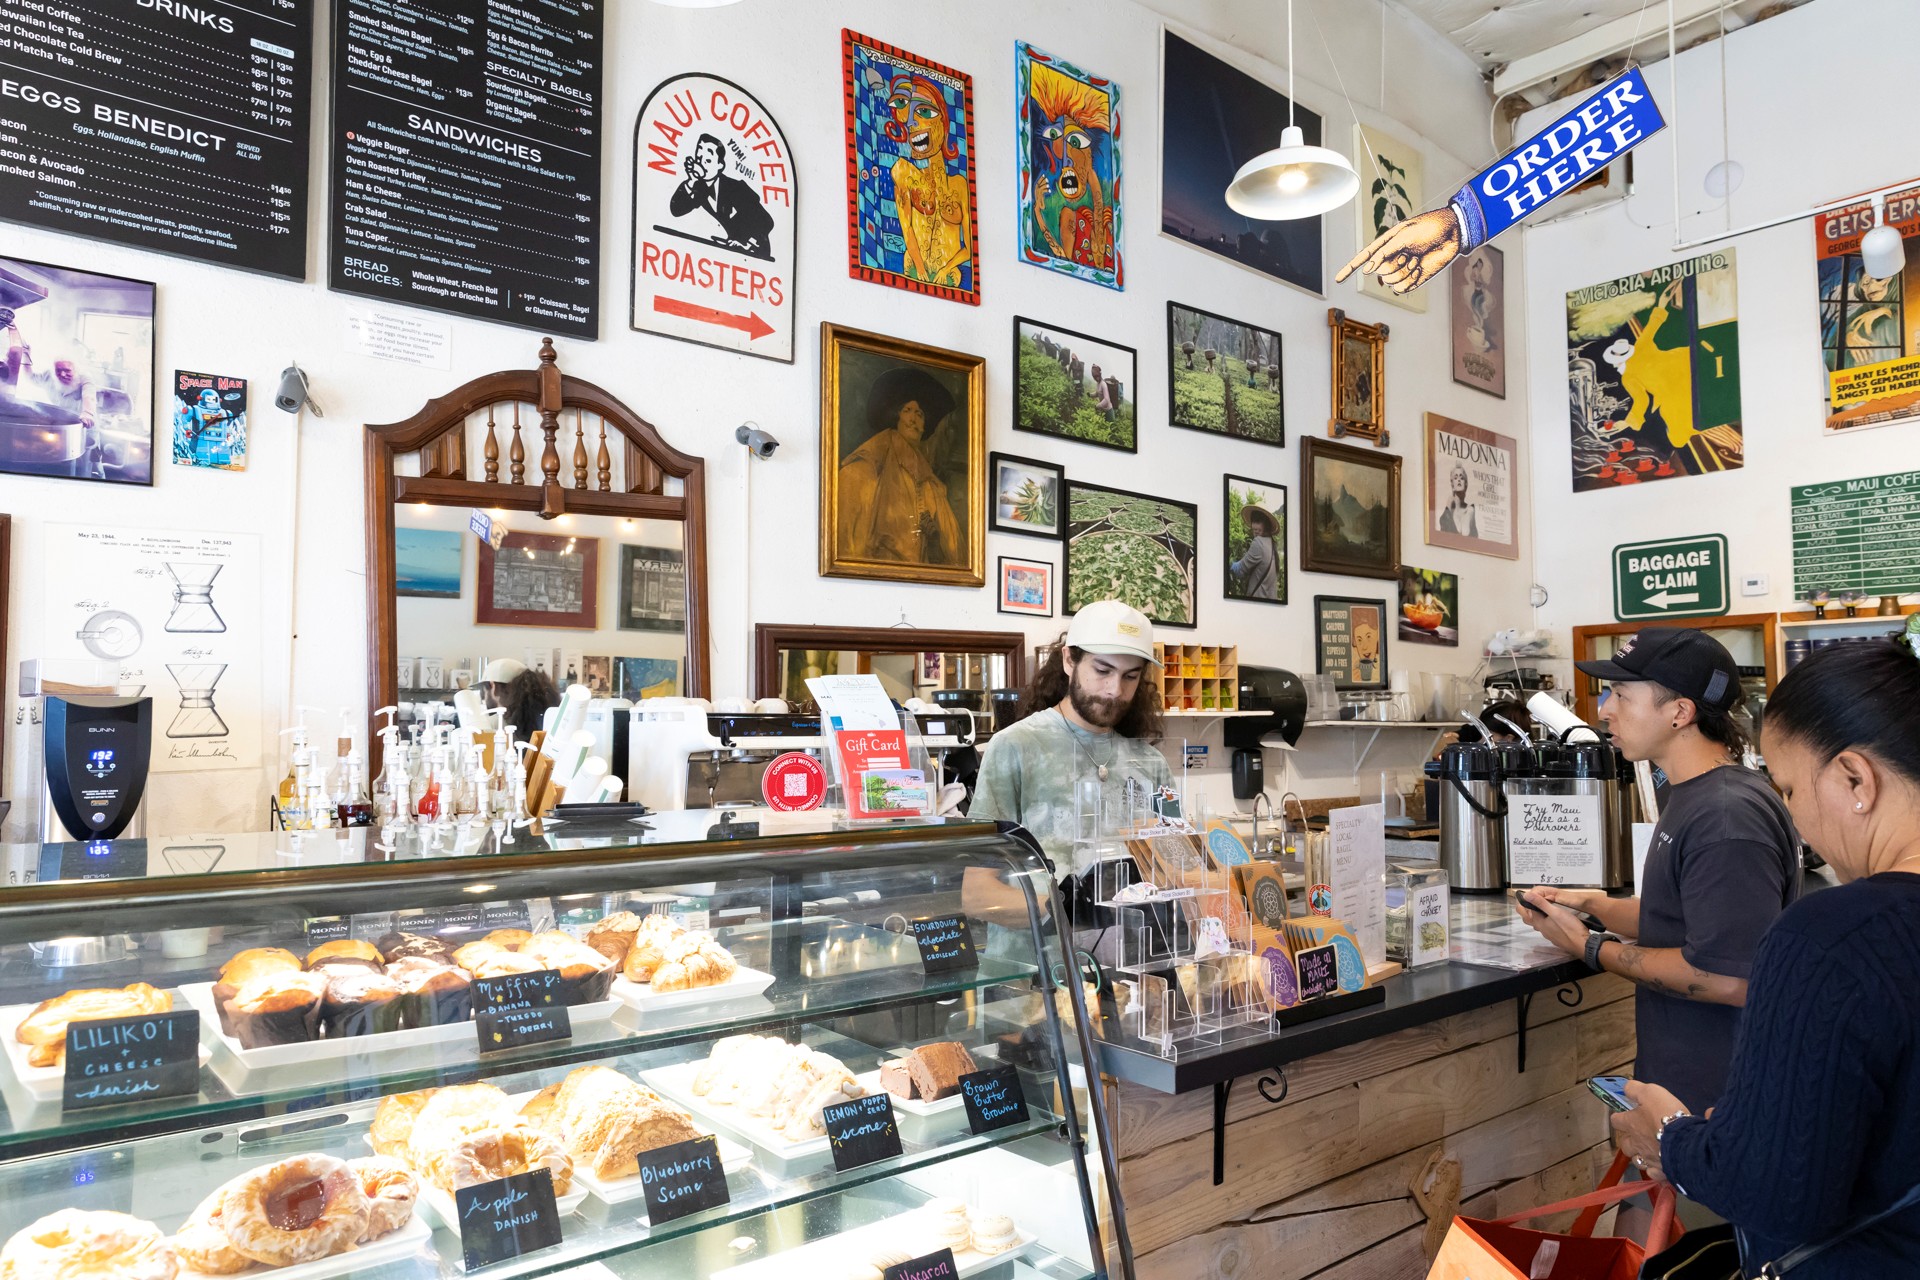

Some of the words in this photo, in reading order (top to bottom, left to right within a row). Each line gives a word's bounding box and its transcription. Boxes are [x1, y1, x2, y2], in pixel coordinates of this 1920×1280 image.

[47, 6, 81, 24] Coffee
[48, 21, 64, 33] Ice
[66, 26, 84, 39] Tea
[348, 10, 379, 27] Smoked
[381, 21, 410, 37] Salmon
[411, 30, 432, 44] Bagel
[14, 25, 67, 49] Chocolate
[70, 42, 92, 56] Cold
[95, 49, 122, 64] Brew
[14, 40, 53, 60] Matcha
[56, 53, 74, 66] Tea
[509, 36, 529, 49] Bacon
[530, 42, 554, 58] Burrito
[348, 55, 381, 72] Cheddar
[382, 65, 410, 81] Cheese
[411, 74, 432, 87] Bagel
[486, 61, 546, 87] SPECIALTY
[550, 81, 593, 102] BAGELS
[486, 79, 523, 97] Sourdough
[524, 90, 547, 104] Bagels
[2, 79, 81, 114] EGGS
[94, 104, 226, 151] BENEDICT
[486, 99, 513, 114] Organic
[514, 107, 537, 120] Bagels
[73, 123, 95, 136] Eggs,
[97, 129, 148, 149] Hollandaise,
[150, 143, 178, 157] English
[180, 150, 206, 163] Muffin
[356, 133, 383, 149] Veggie
[384, 141, 410, 155] Burger
[408, 114, 542, 163] SANDWICHES
[1483, 80, 1644, 197] ORDER
[648, 89, 702, 176] MAUI
[710, 91, 790, 208] COFFEE
[727, 138, 746, 162] YUM!
[40, 157, 85, 175] Avocado
[346, 155, 366, 167] Oven
[368, 160, 399, 176] Roasted
[400, 169, 426, 184] Turkey
[735, 160, 756, 180] YUM!
[1503, 113, 1642, 220] HERE
[38, 171, 76, 188] Salmon
[345, 202, 363, 214] Crab
[365, 207, 387, 219] Salad
[345, 225, 364, 237] Tuna
[365, 230, 388, 243] Caper
[1828, 238, 1860, 254] GEORGE
[344, 256, 389, 273] BREAD
[641, 241, 784, 307] ROASTERS
[343, 268, 403, 287] CHOICES:
[412, 270, 434, 283] Whole
[436, 275, 460, 289] Wheat,
[461, 280, 483, 292] French
[1578, 272, 1645, 306] VICTORIA
[1650, 253, 1725, 287] ARDUINO
[411, 282, 449, 298] Sourdough
[458, 291, 484, 303] Brioche
[533, 305, 553, 318] Gluten
[554, 310, 567, 320] Free
[568, 313, 586, 324] Bread
[539, 297, 571, 311] Croissant,
[572, 304, 590, 315] Bagel
[180, 375, 213, 390] SPACE
[218, 377, 243, 390] MAN
[1836, 380, 1867, 393] SPASS
[1870, 370, 1919, 386] GEMACHT
[1854, 371, 1873, 381] HAT
[1876, 368, 1887, 376] ES
[1837, 389, 1869, 401] ANGST
[1872, 386, 1886, 394] ZU
[1439, 432, 1506, 471] MADONNA
[1846, 478, 1879, 492] MAUI
[1628, 550, 1711, 573] BAGGAGE
[1642, 571, 1697, 590] CLAIM
[92, 750, 113, 760] 192
[845, 738, 868, 755] Gift
[871, 737, 900, 751] Card
[772, 758, 797, 776] CONNECT
[797, 757, 812, 768] WITH
[811, 765, 818, 775] US
[1419, 893, 1438, 906] AFRAID
[400, 918, 435, 926] MONIN
[444, 915, 478, 923] MONIN
[486, 911, 519, 919] MONIN
[311, 925, 348, 935] MONIN
[914, 919, 958, 933] SOURDOUGH
[919, 930, 962, 946] chocolate
[926, 950, 959, 960] CROISSANT
[75, 1080, 160, 1099] danish
[963, 1080, 999, 1096] Brown
[974, 1088, 1007, 1107] Butter
[825, 1104, 857, 1124] LEMON
[862, 1095, 887, 1108] POPPY
[981, 1102, 1018, 1121] Brownie
[837, 1121, 887, 1141] scone
[641, 1155, 712, 1184] Blueberry
[657, 1181, 703, 1203] Scone
[464, 1188, 528, 1219] Apple
[494, 1210, 538, 1232] DANISH
